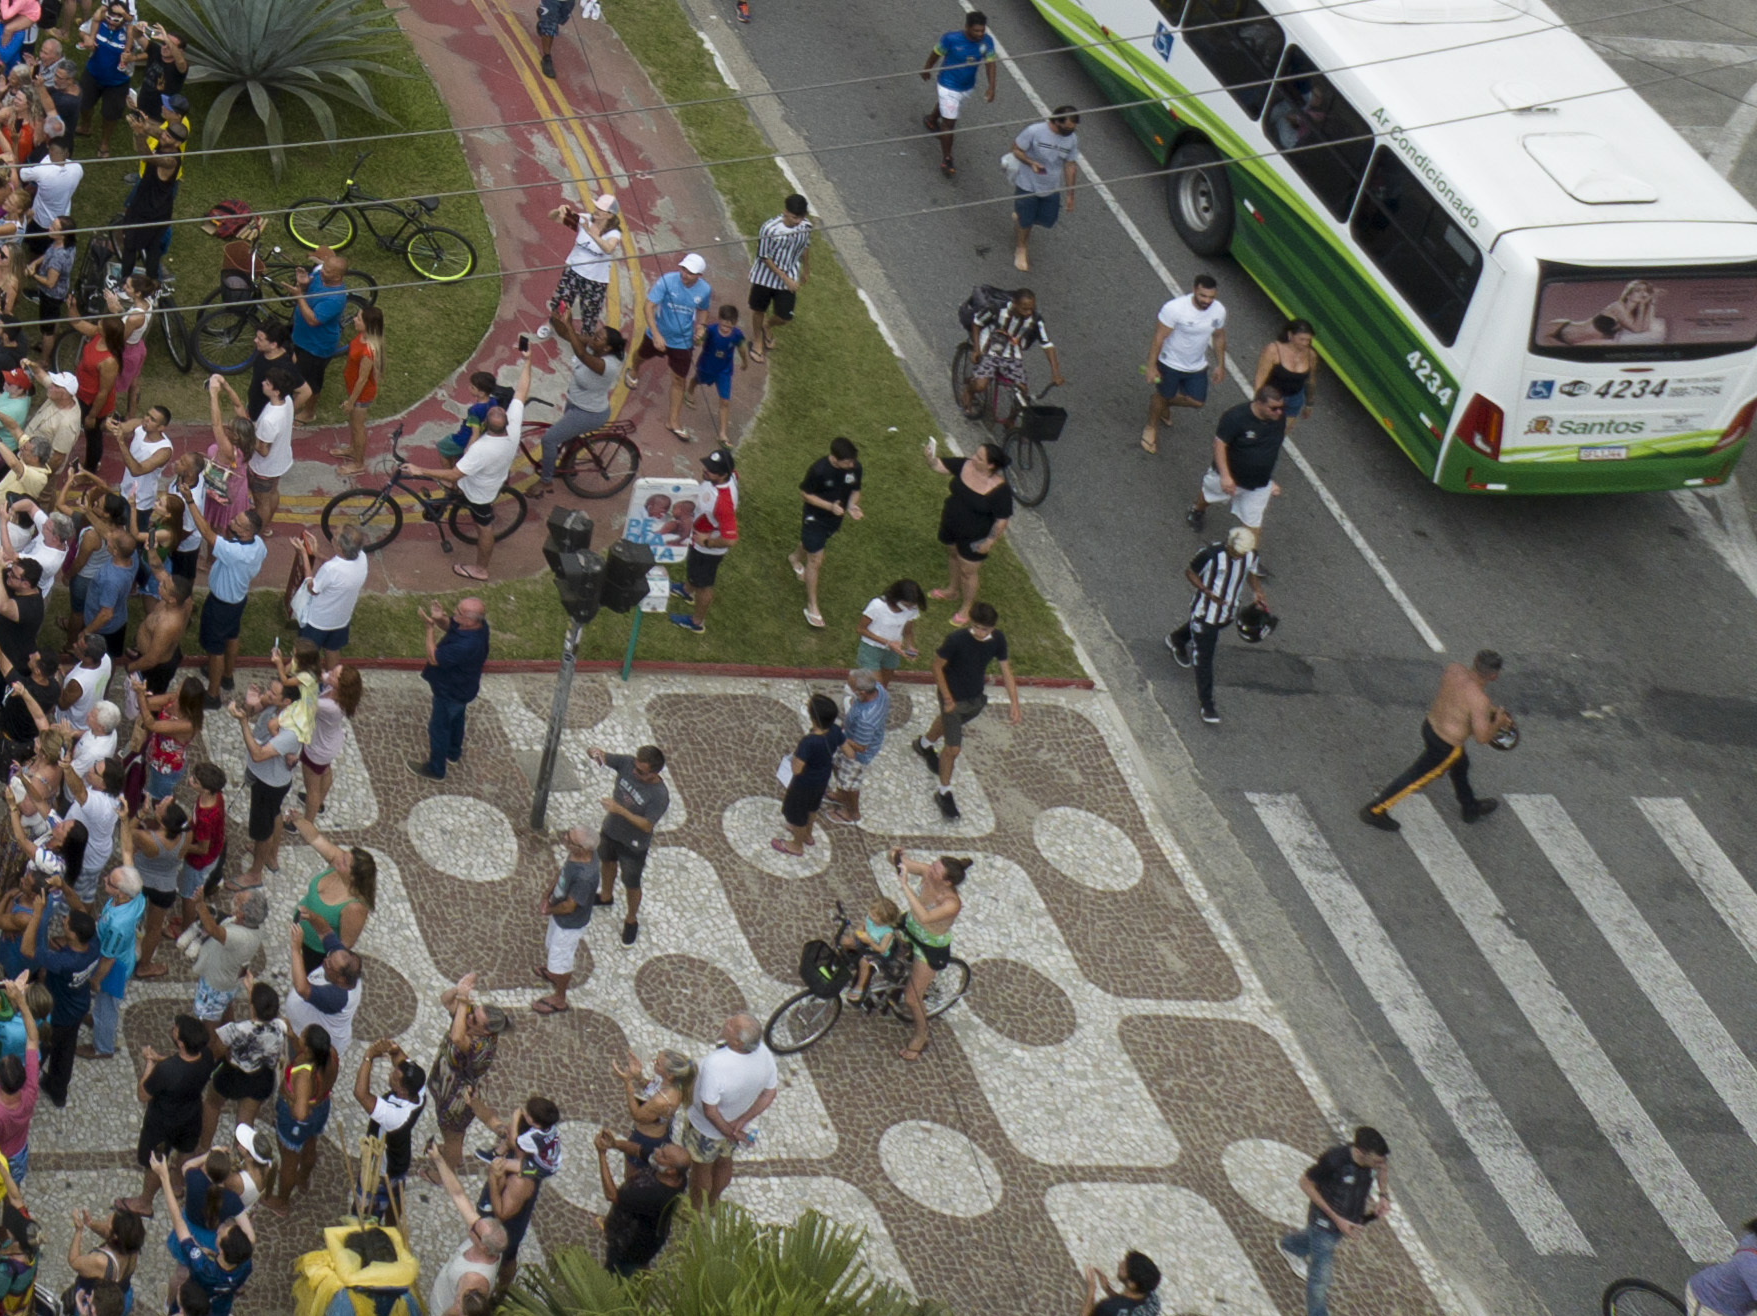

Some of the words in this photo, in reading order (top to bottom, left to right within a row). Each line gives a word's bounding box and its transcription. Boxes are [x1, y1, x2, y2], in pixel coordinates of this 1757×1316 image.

[1371, 107, 1389, 129] Ar
[1389, 125, 1481, 230] Condicionado
[1405, 349, 1455, 408] 4234
[1595, 379, 1668, 399] 4234
[1556, 417, 1645, 436] Santos
[627, 517, 655, 535] PE
